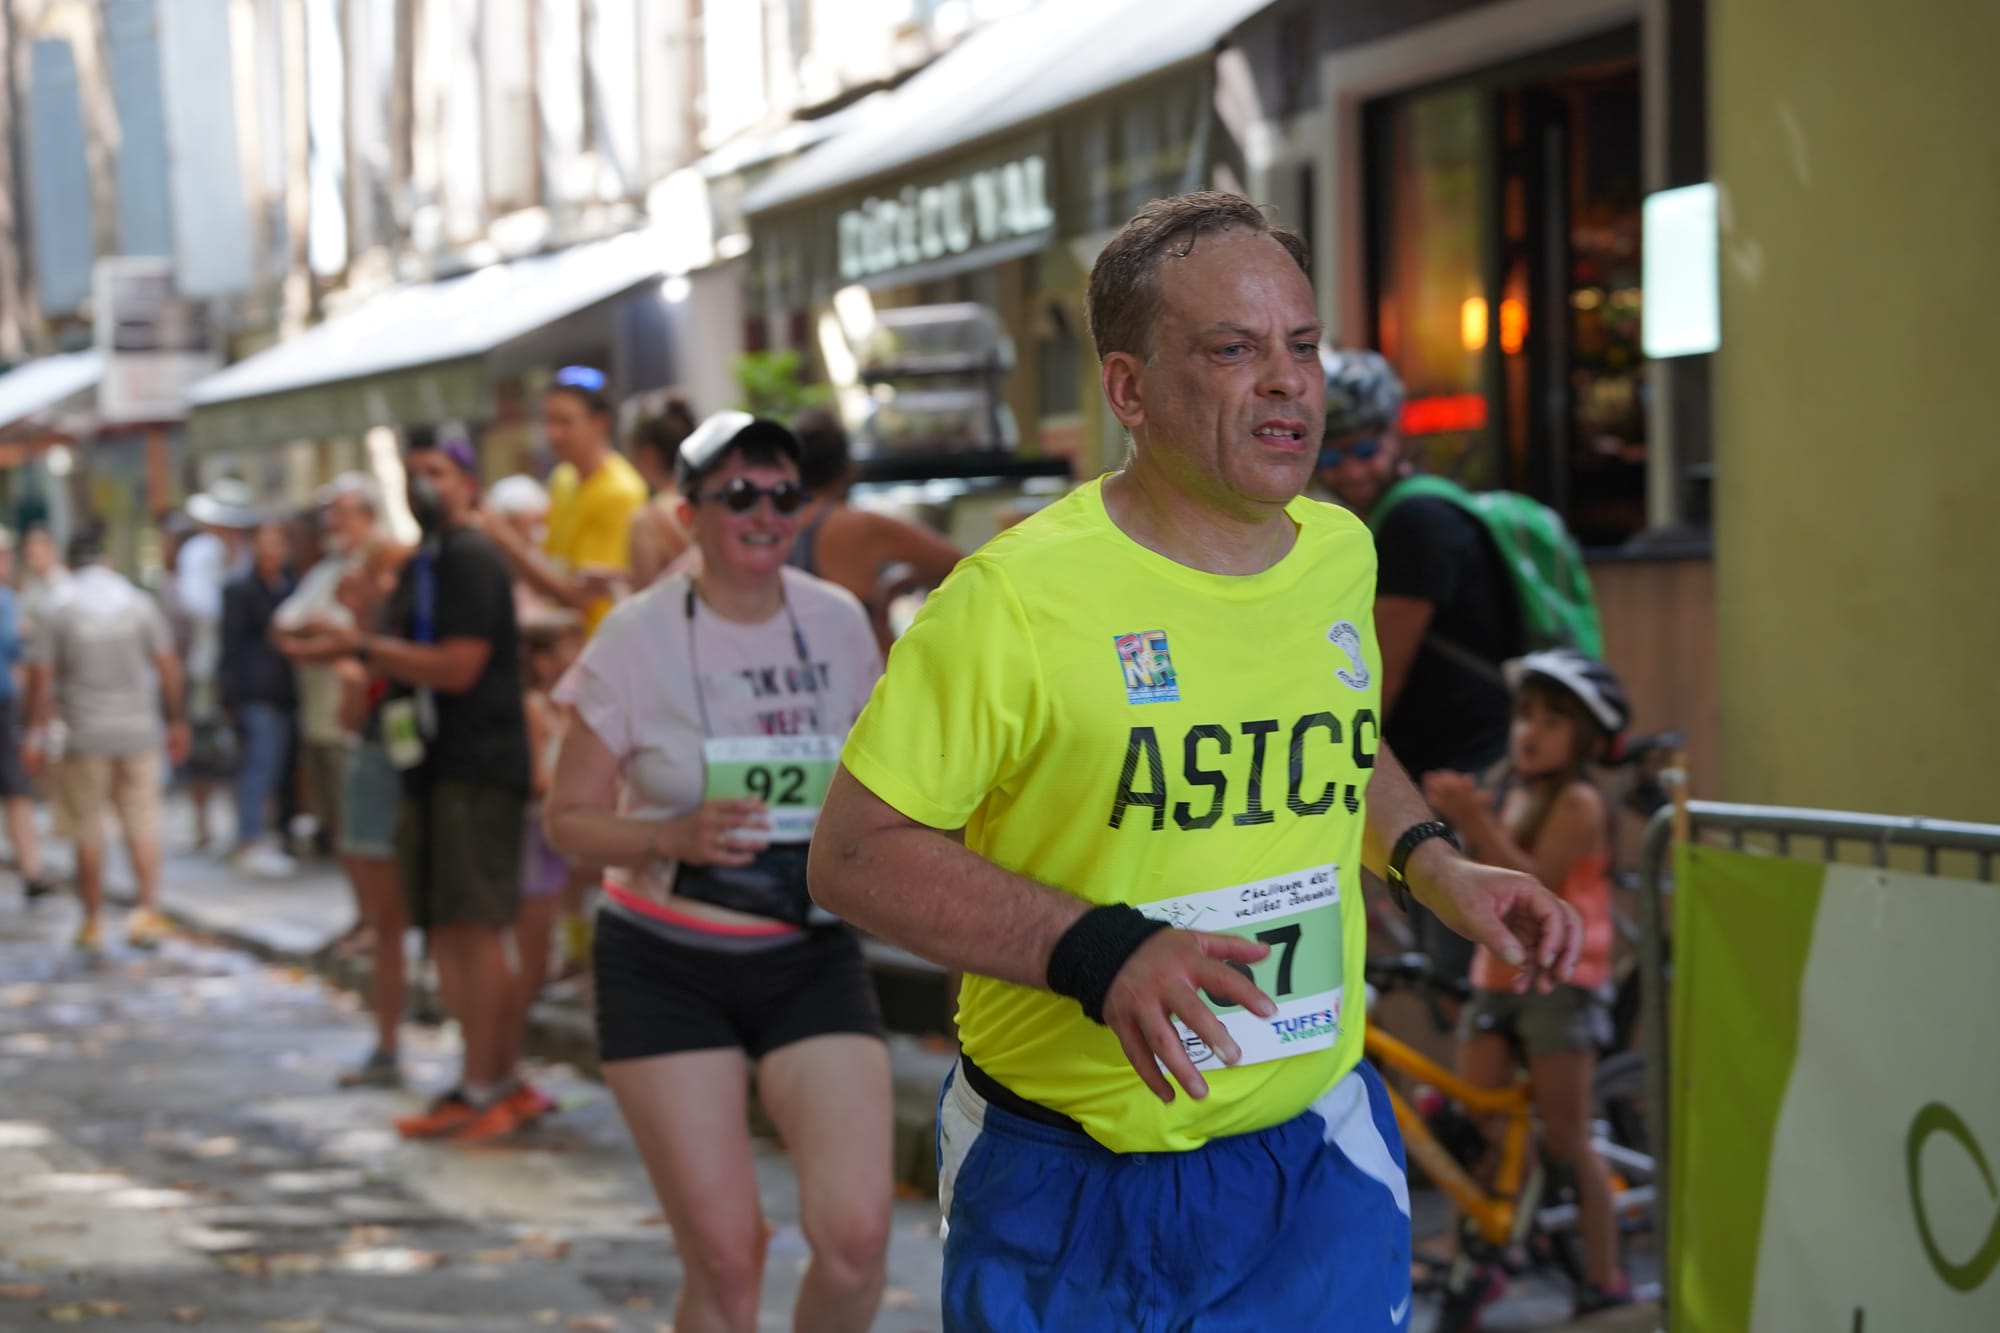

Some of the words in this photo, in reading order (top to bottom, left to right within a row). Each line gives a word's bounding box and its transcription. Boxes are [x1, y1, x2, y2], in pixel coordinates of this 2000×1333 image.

[744, 765, 807, 805] 92
[1107, 708, 1378, 831] ASICS
[1199, 922, 1302, 1008] 7
